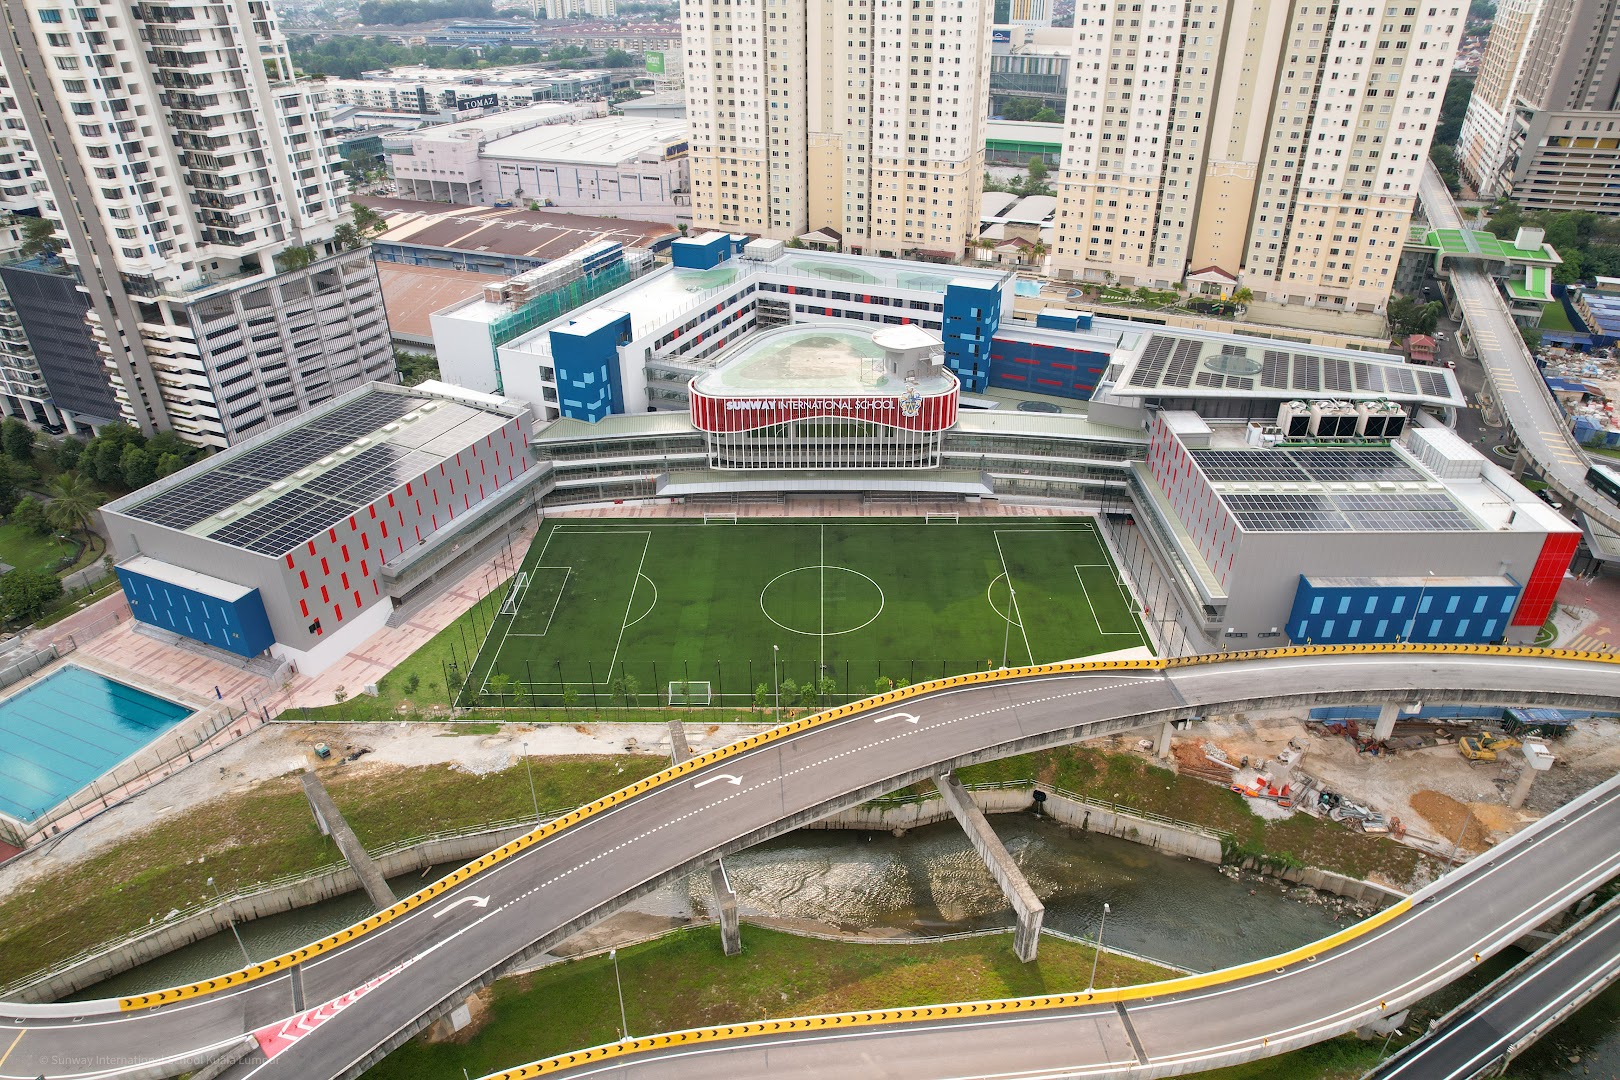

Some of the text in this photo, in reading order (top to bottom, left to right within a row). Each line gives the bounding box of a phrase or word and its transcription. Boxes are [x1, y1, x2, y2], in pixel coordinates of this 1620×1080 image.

[464, 97, 494, 109] TOMAZ
[726, 400, 895, 410] SUNWAY INTERNATIONAL SCHOOL
